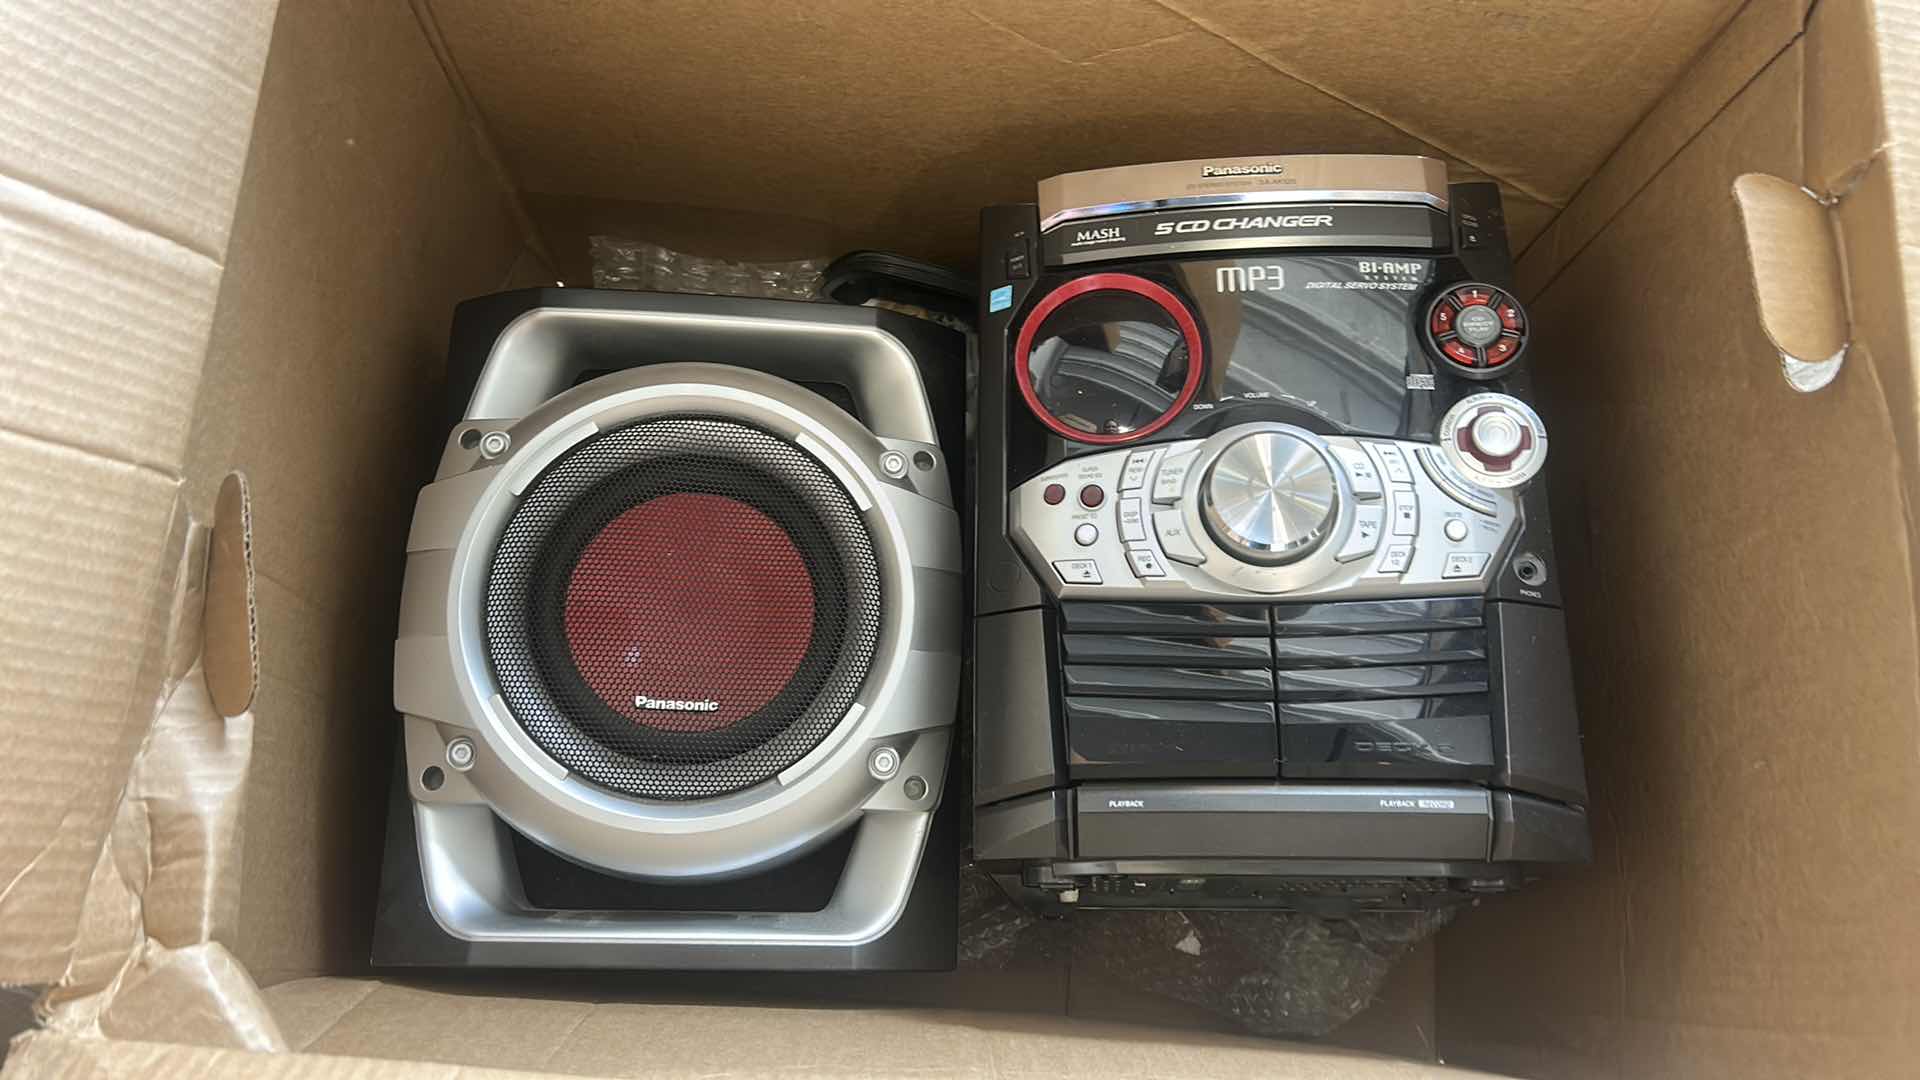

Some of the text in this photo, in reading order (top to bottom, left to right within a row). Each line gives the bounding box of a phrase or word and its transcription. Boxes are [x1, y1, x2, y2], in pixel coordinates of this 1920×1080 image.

[1203, 163, 1283, 177] Panasonic
[1212, 215, 1334, 231] CHANGER
[1076, 227, 1120, 242] MASH
[1216, 265, 1285, 293] MP3
[1304, 281, 1418, 291] DIGITAL SERVO SYSTEM
[1472, 289, 1478, 299] 1
[1439, 312, 1448, 321] 5
[1359, 520, 1377, 529] TAPE
[1166, 527, 1181, 537] AUX
[635, 695, 719, 711] Panasonic
[1108, 800, 1144, 808] PLAYBACK
[1380, 799, 1416, 808] PLAYBACK
